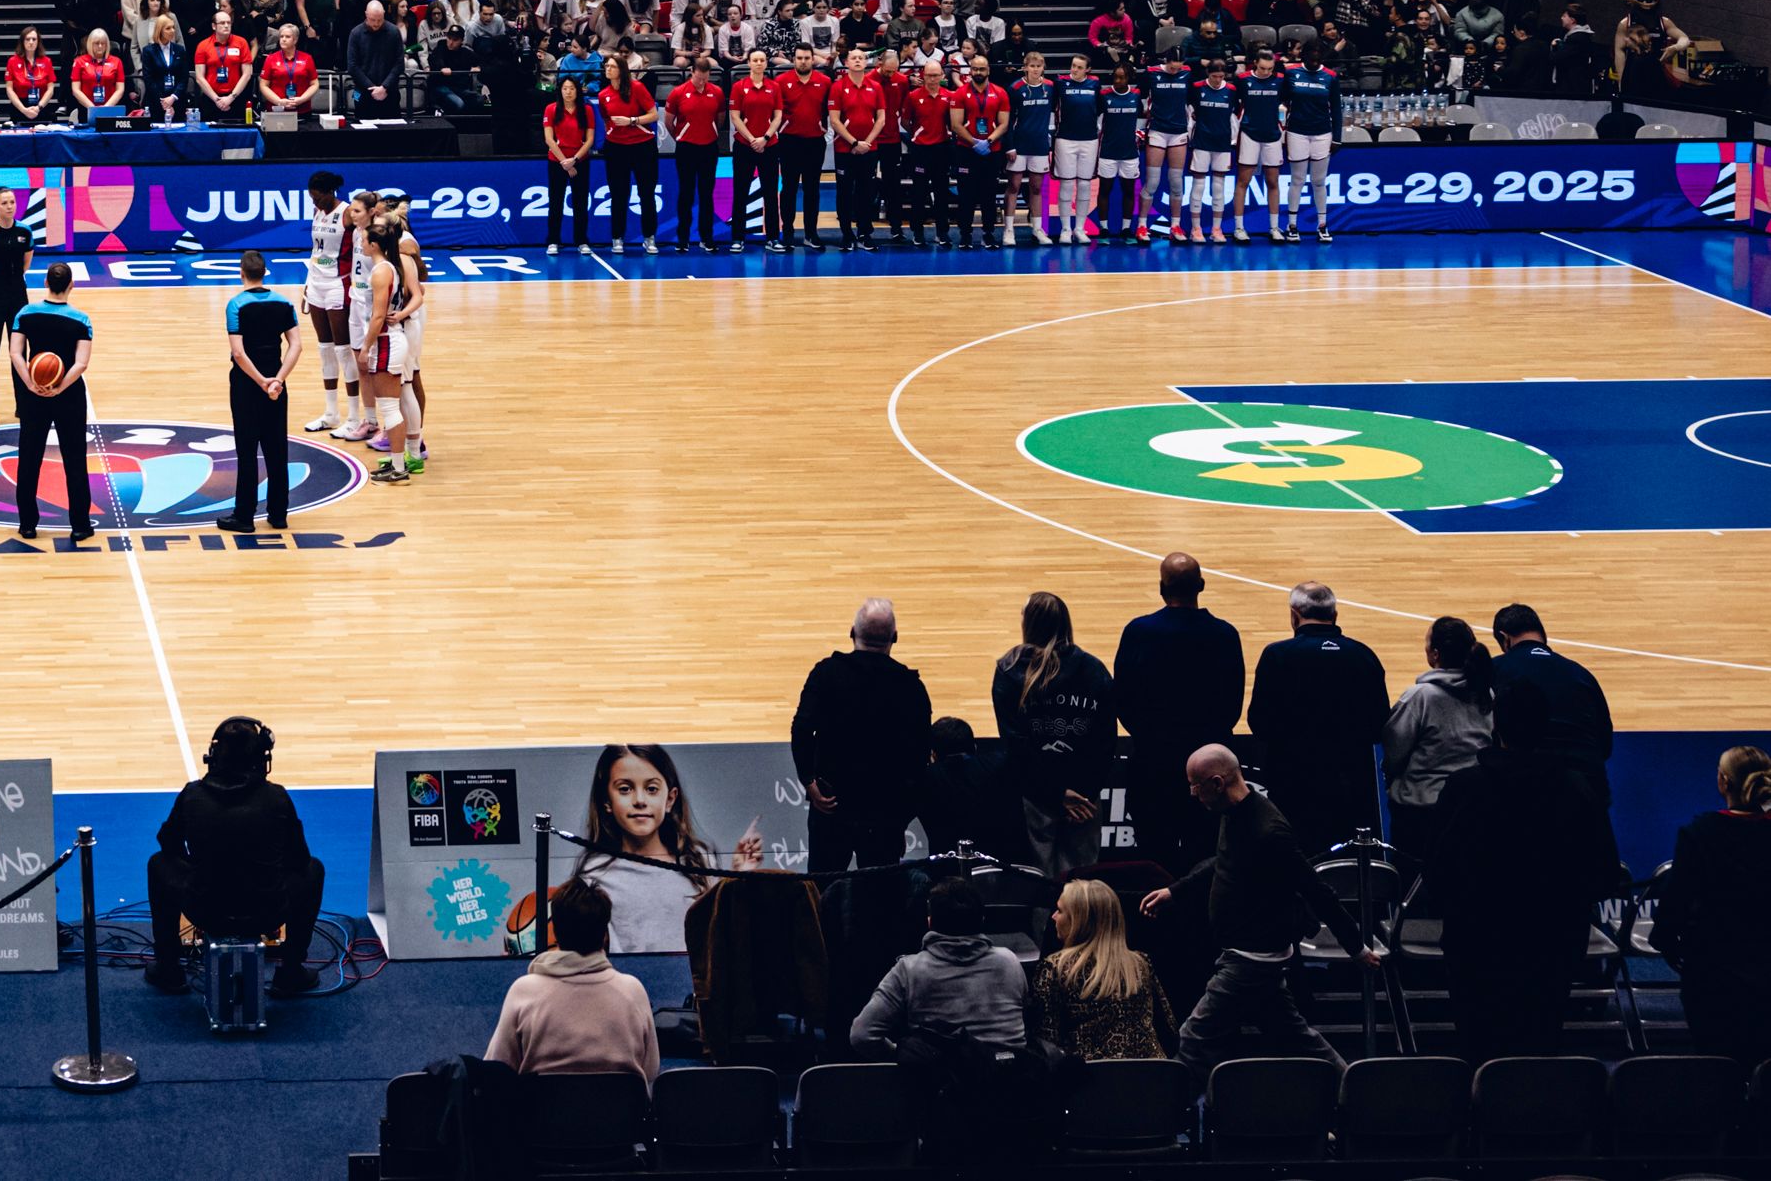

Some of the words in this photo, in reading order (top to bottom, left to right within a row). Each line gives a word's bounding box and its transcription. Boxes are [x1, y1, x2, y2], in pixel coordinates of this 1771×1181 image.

[762, 6, 768, 14] 5
[115, 120, 132, 129] POSS.
[1324, 172, 1484, 208] 18-29,
[1493, 169, 1635, 202] 2025
[355, 260, 362, 275] 2
[414, 814, 439, 827] FIBA
[452, 877, 473, 891] HER
[446, 886, 485, 904] WORLD,
[458, 900, 479, 913] HER
[0, 912, 47, 924] DREAMS.
[455, 909, 487, 926] RULES
